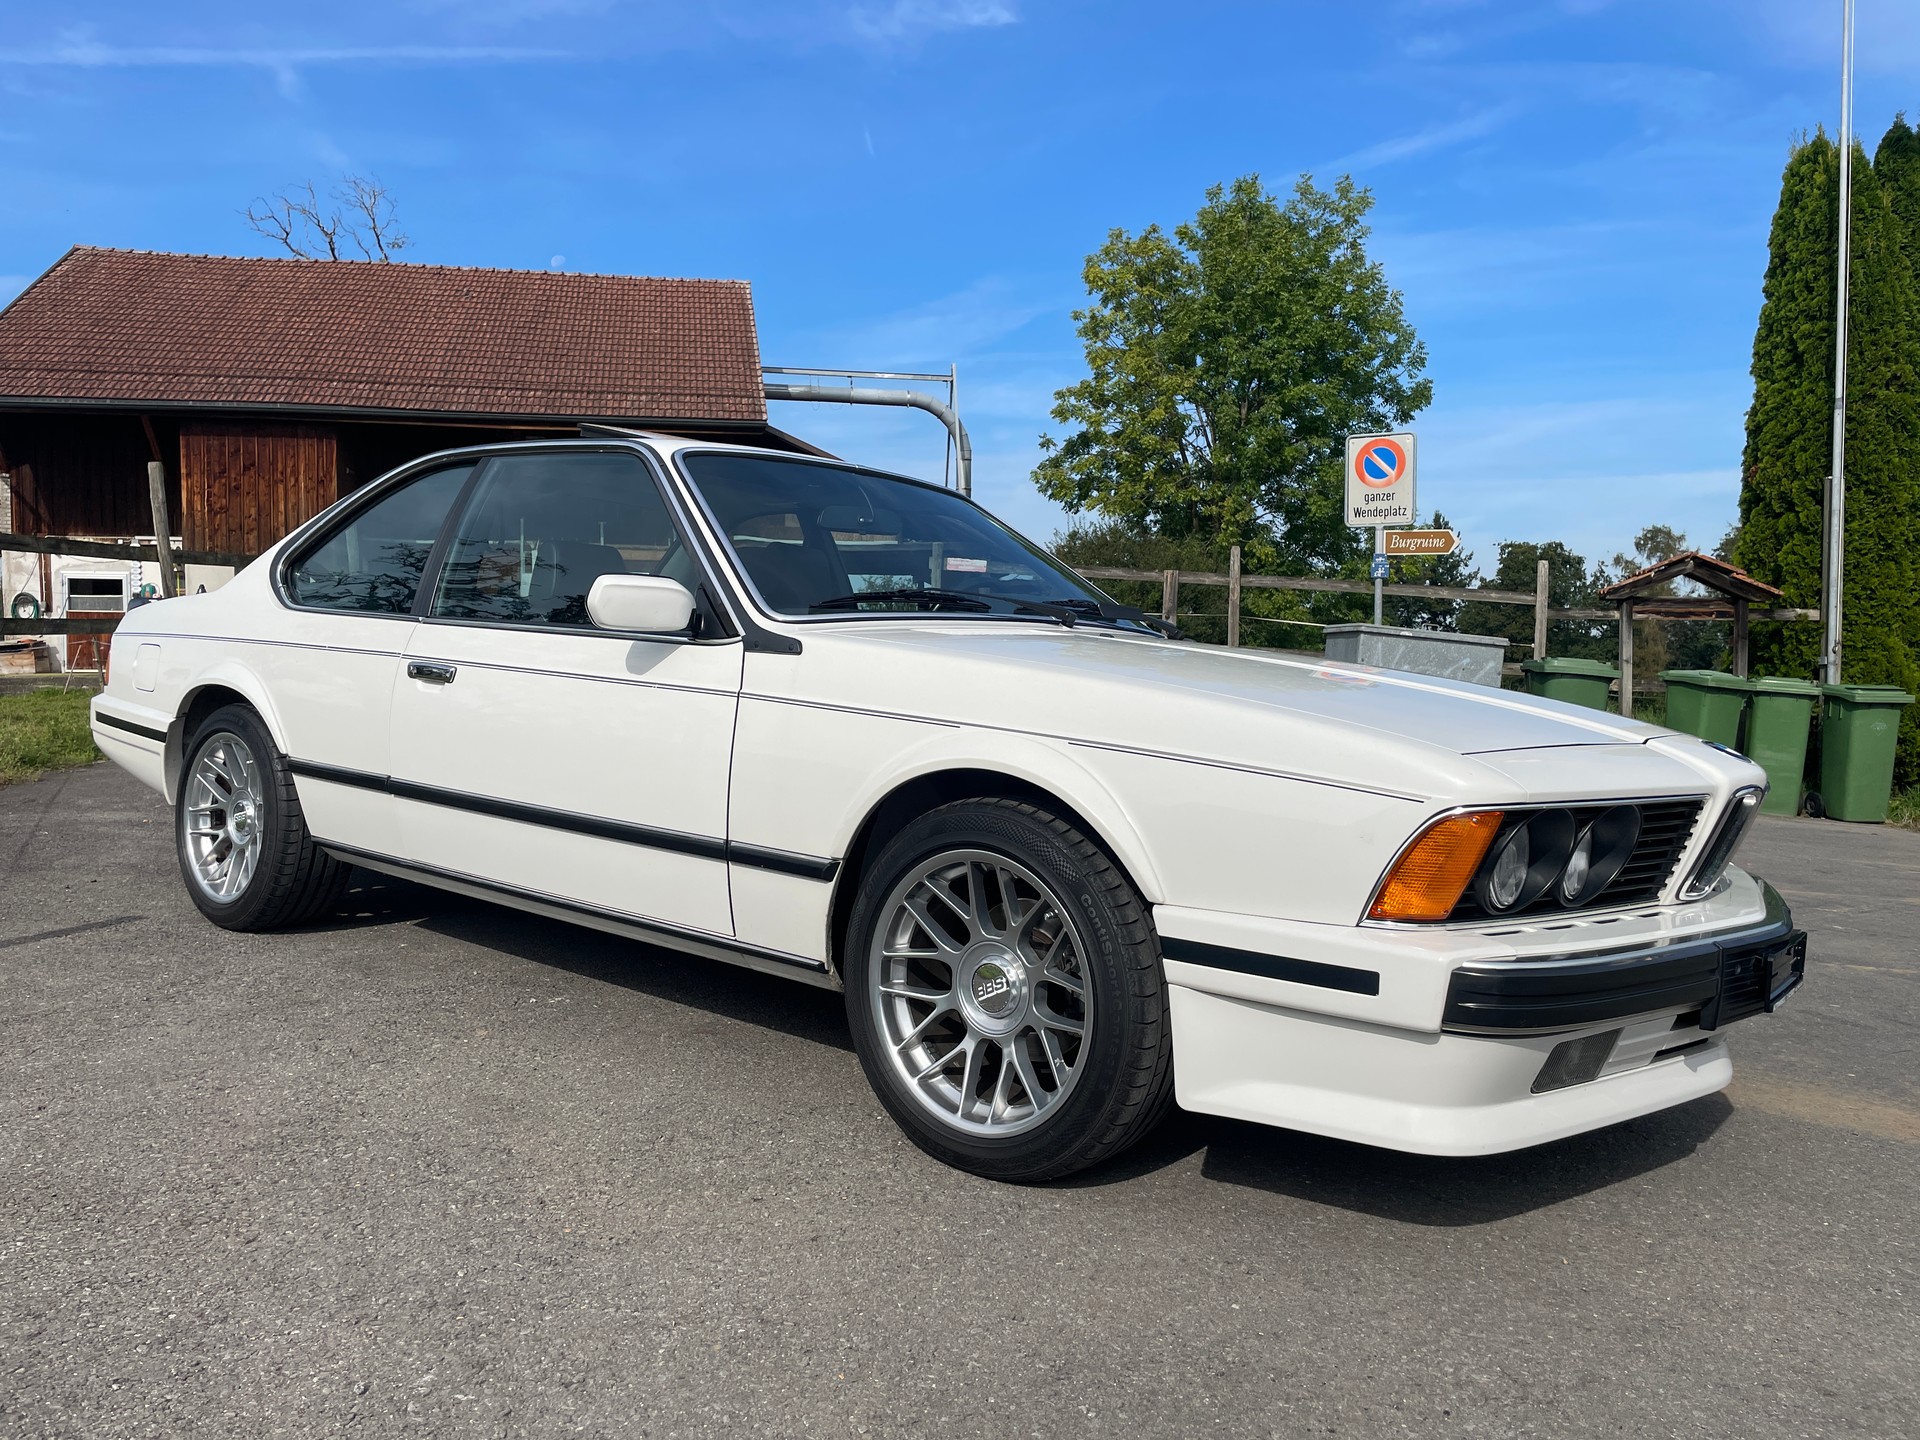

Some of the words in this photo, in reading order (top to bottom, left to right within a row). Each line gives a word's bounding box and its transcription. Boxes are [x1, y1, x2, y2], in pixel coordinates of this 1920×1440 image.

[1364, 491, 1396, 505] ganzer
[1353, 505, 1407, 519] Wendeplatz
[1390, 534, 1446, 550] Burgruine
[977, 976, 1007, 1001] BBS
